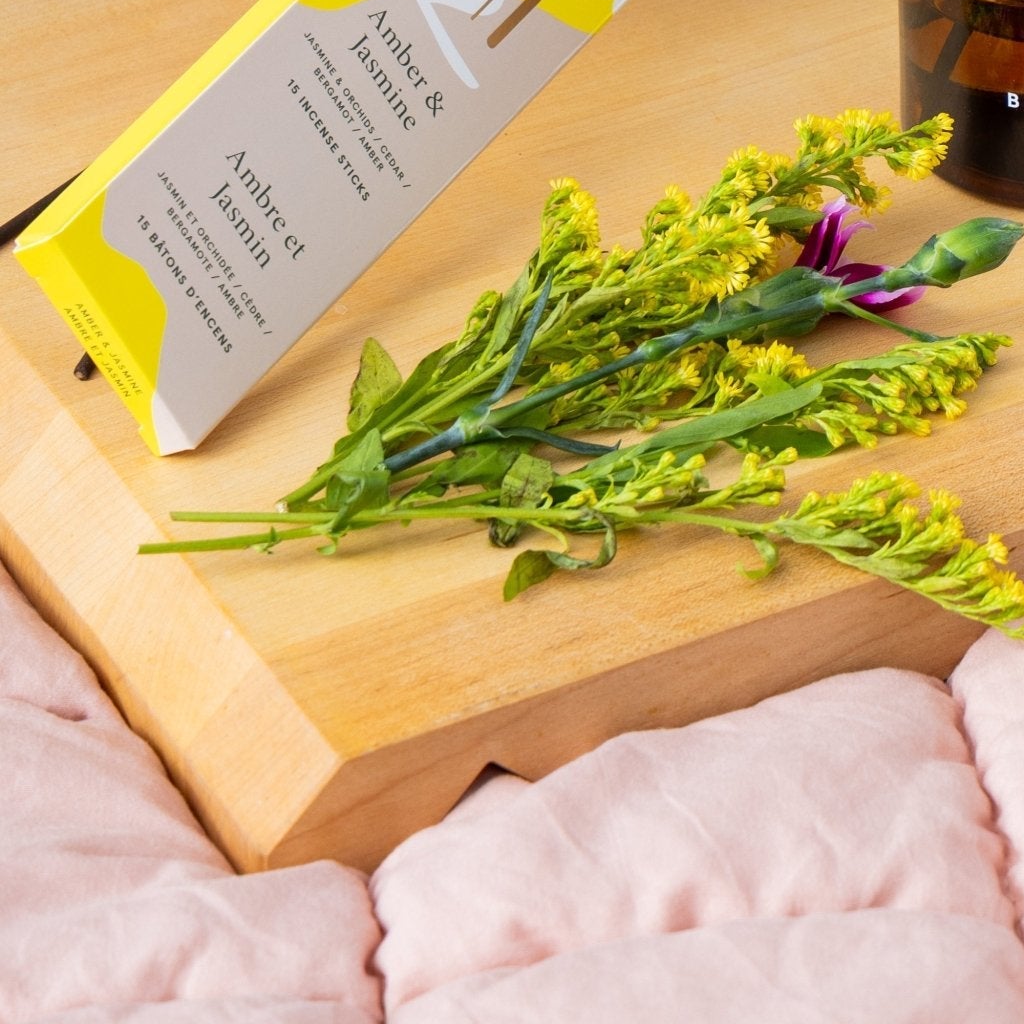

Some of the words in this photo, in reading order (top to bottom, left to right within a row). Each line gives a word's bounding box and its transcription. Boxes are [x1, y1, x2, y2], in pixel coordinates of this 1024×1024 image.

[304, 32, 337, 76] JASMINE
[335, 77, 343, 86] &
[343, 87, 375, 134] ORCHIDS
[380, 145, 405, 181] CEDAR
[348, 33, 416, 131] Jasmine
[367, 9, 428, 90] Amber
[425, 91, 444, 118] &
[287, 79, 300, 95] 15
[298, 96, 339, 153] INCENSE
[337, 154, 370, 202] STICKS
[313, 67, 355, 124] BERGAMOT
[358, 136, 384, 172] AMBER
[136, 215, 150, 231] 15
[149, 233, 187, 285] BÂTONS
[157, 171, 187, 210] JASMIN
[185, 211, 198, 225] ET
[197, 227, 235, 281] ORCHIDÉE
[208, 181, 271, 270] Jasmin
[225, 150, 286, 232] Ambre
[284, 235, 305, 260] et
[166, 207, 213, 272] BERGAMOTE
[218, 283, 244, 320] AMBRE
[64, 308, 90, 342] AMBRE
[102, 362, 131, 398] JASMIN
[76, 303, 103, 338] AMBER
[109, 352, 143, 396] JASMINE
